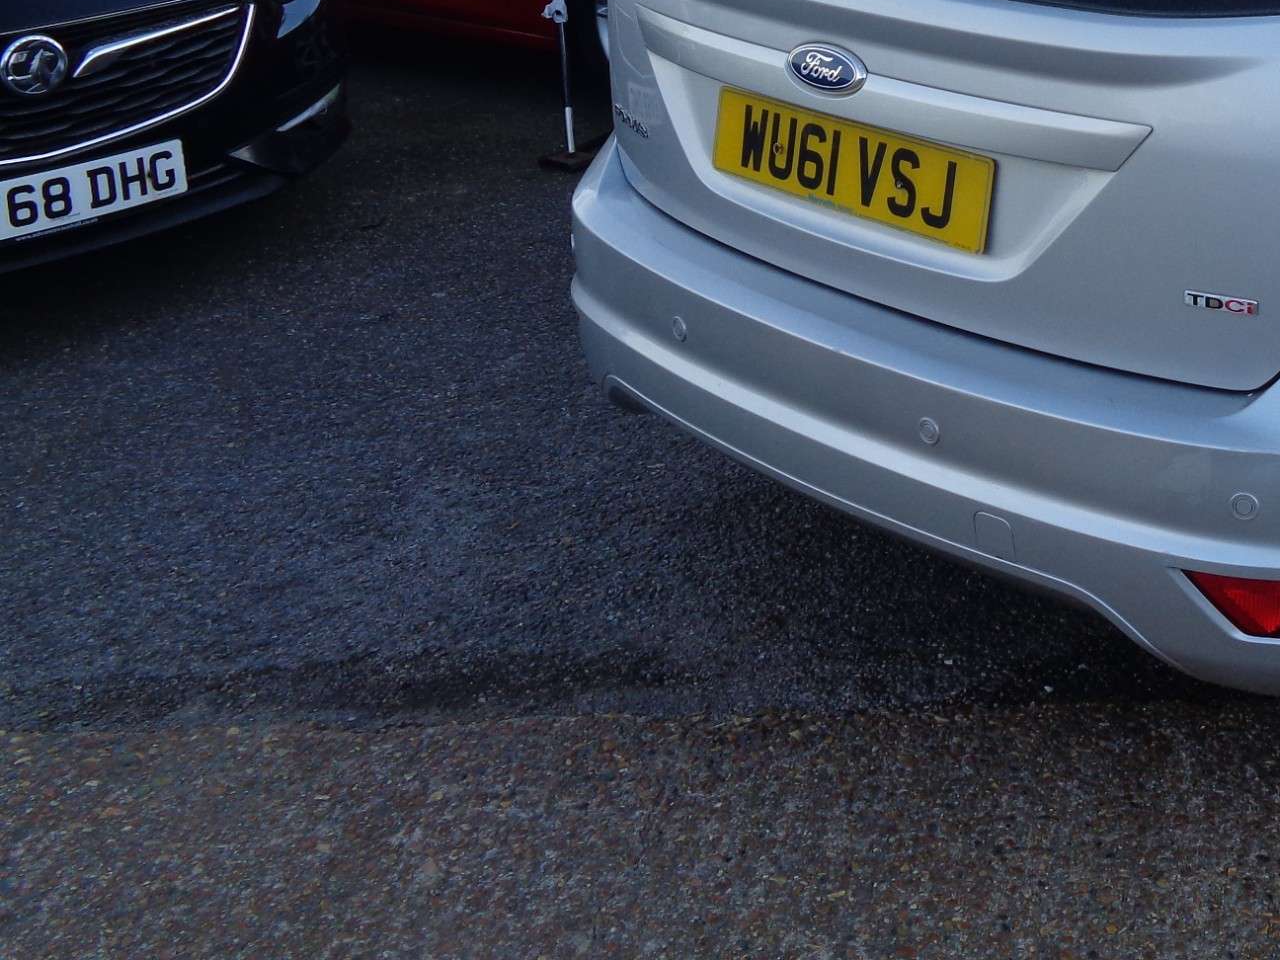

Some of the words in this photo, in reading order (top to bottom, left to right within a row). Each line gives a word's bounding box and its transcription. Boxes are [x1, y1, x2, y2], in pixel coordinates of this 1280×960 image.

[800, 51, 843, 82] Ford
[6, 176, 73, 228] 68
[87, 150, 176, 209] DHG
[741, 104, 841, 197] WU61
[859, 136, 957, 229] VSJ
[1187, 292, 1255, 314] TDCi
